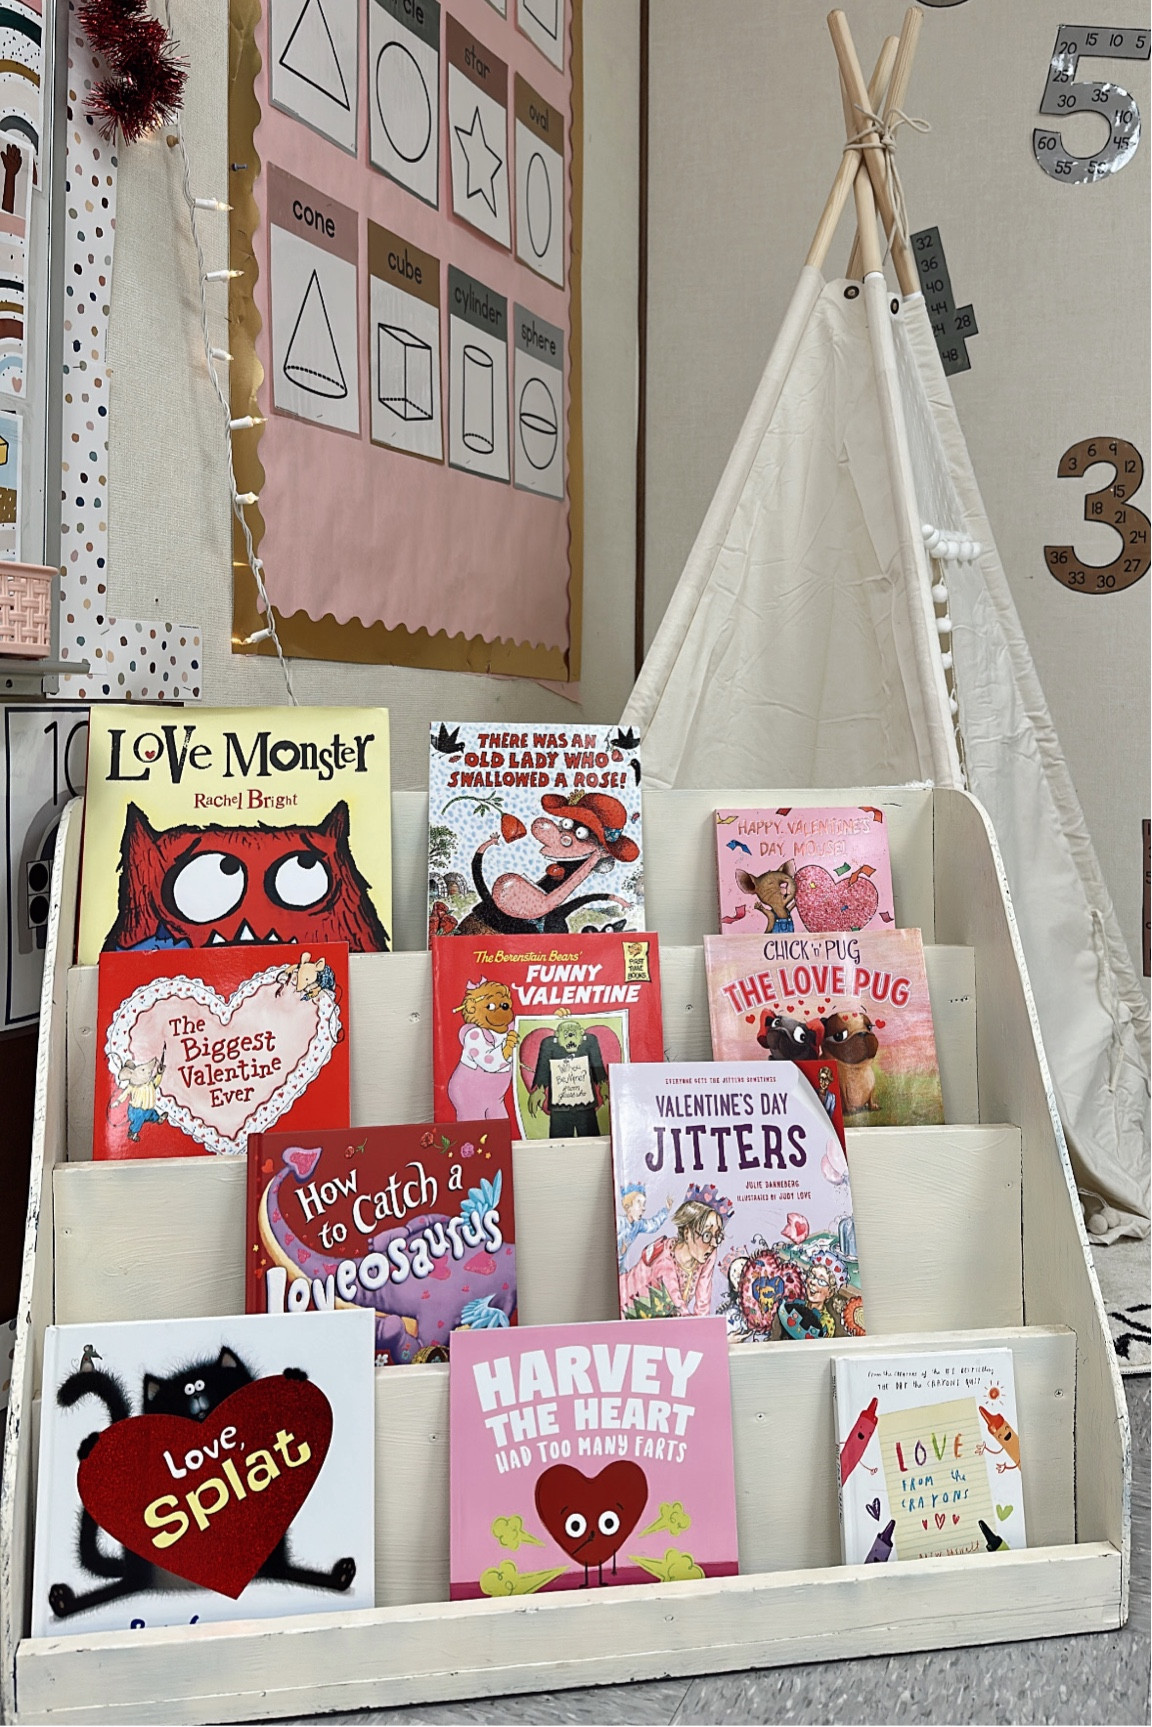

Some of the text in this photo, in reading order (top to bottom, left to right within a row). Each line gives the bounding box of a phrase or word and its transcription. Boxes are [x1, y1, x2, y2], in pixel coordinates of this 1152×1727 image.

[1059, 42, 1078, 54] 20
[1086, 33, 1146, 48] 15 10 5
[464, 45, 491, 79] star
[1052, 70, 1070, 83] 25
[1057, 88, 1110, 108] 30 35
[529, 103, 549, 132] oval
[1038, 136, 1130, 150] 60 45
[1055, 160, 1073, 175] 55
[292, 200, 336, 238] cone
[916, 235, 933, 251] 32
[387, 248, 423, 285] cube
[921, 256, 938, 272] 36
[926, 279, 944, 294] 40
[454, 284, 503, 327] cylinder
[930, 301, 948, 315] 44
[954, 314, 971, 330] 28
[521, 321, 556, 356] sphere
[942, 348, 958, 363] 48
[1087, 444, 1097, 457] 6
[1108, 442, 1118, 456] 9
[1068, 458, 1078, 470] 3
[1124, 460, 1136, 473] 12
[1113, 484, 1126, 498] 15
[1091, 502, 1103, 515] 18
[1114, 510, 1126, 524] 21
[1130, 530, 1146, 544] 24
[1050, 551, 1068, 564] 36
[1124, 559, 1141, 572] 27
[1068, 571, 1086, 585] 33
[1096, 575, 1116, 589] 30
[478, 732, 597, 750] THERE WAS AN
[222, 731, 375, 780] Monster
[464, 752, 610, 769] OLD LADY WHO
[448, 772, 627, 789] SWALLOWED A ROSE!
[194, 789, 298, 810] Rachel Bright
[787, 818, 870, 836] VALENTINE'S
[474, 950, 582, 963] The Berenstain Bears'
[764, 940, 808, 962] CHICK
[826, 940, 860, 964] PUG
[526, 964, 602, 983] FUNNY
[512, 982, 642, 1006] VALENTINE
[722, 965, 912, 1015] THE LOVE PUG
[169, 1016, 206, 1036] The
[181, 1030, 276, 1062] Biggest
[178, 1056, 282, 1088] Valentine
[210, 1088, 254, 1108] Ever
[656, 1092, 788, 1118] VALENTINE'S DAY
[645, 1124, 807, 1174] JITTERS
[746, 1181, 762, 1189] JULIE
[295, 1168, 358, 1223] How
[736, 1194, 768, 1202] ILLUSTRATED
[778, 1192, 794, 1200] JUDY
[796, 1192, 812, 1200] LOVE
[317, 1162, 463, 1249] to Catch a
[472, 1344, 704, 1412] HARVEY
[484, 1398, 696, 1448] THE HEART
[163, 1426, 245, 1479] Love,
[495, 1434, 688, 1474] HAD TOO MANY FARTS
[896, 1432, 963, 1472] LOVE
[144, 1428, 312, 1550] Splat
[902, 1469, 966, 1491] FROM the
[902, 1488, 968, 1512] CRAYONS
